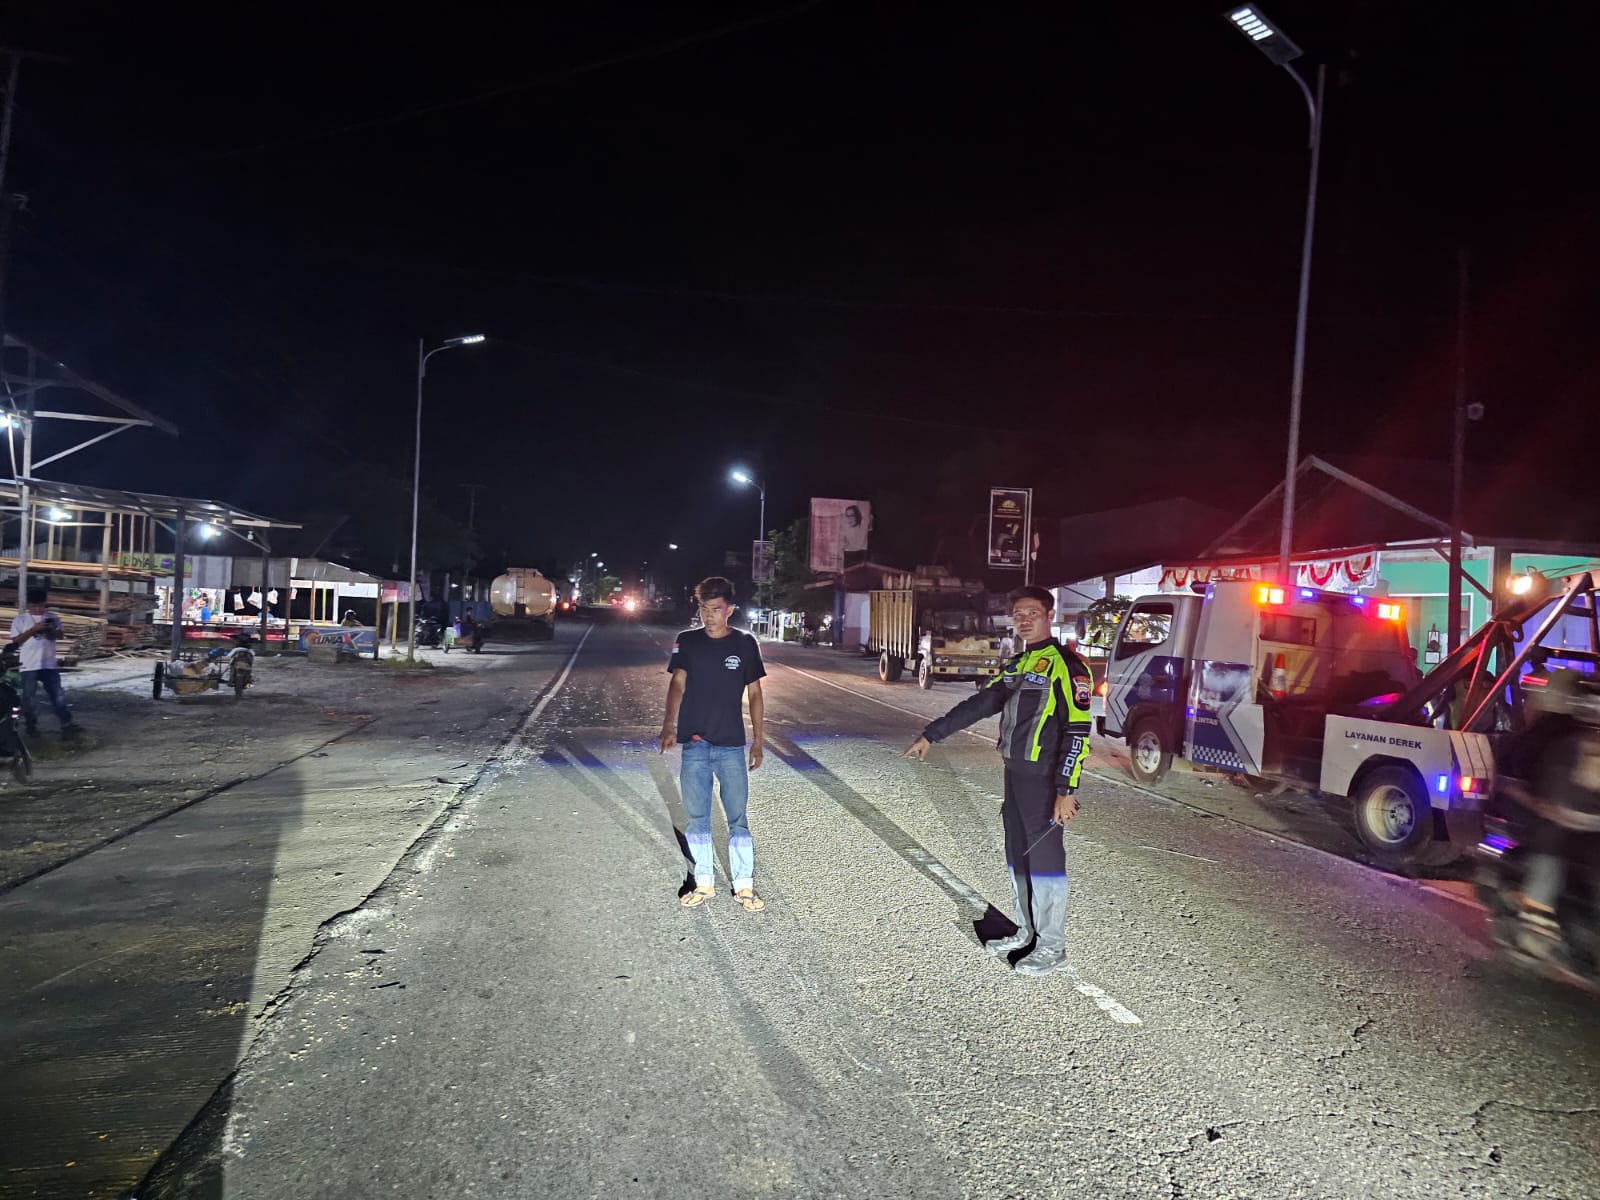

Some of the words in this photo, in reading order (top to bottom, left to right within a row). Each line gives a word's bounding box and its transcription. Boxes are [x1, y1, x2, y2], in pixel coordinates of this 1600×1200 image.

[1024, 672, 1046, 686] POLISI
[1344, 729, 1387, 744] LAYANAN
[1388, 736, 1423, 750] DEREK
